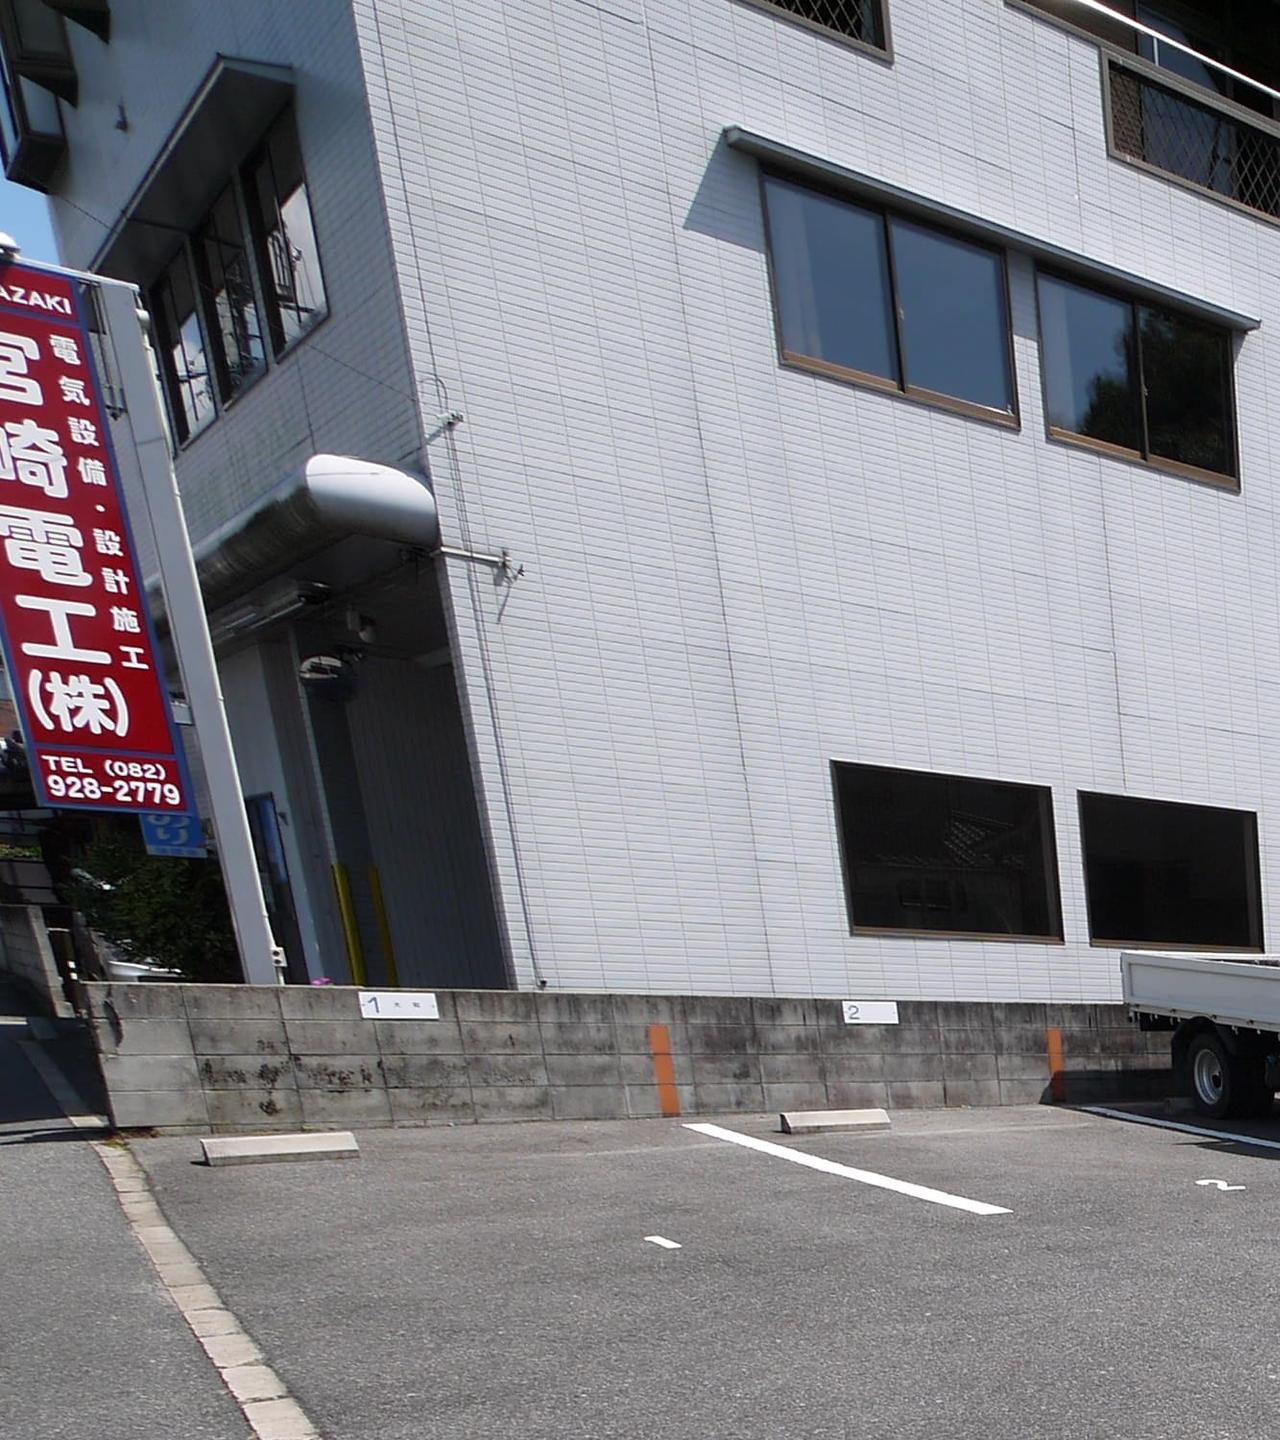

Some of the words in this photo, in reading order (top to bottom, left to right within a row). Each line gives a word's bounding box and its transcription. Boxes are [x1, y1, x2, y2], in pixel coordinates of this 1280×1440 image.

[41, 754, 94, 774] TEL
[104, 758, 166, 780] (082)
[47, 774, 181, 806] 928-2779
[367, 996, 380, 1014] 1
[847, 1005, 860, 1020] 2
